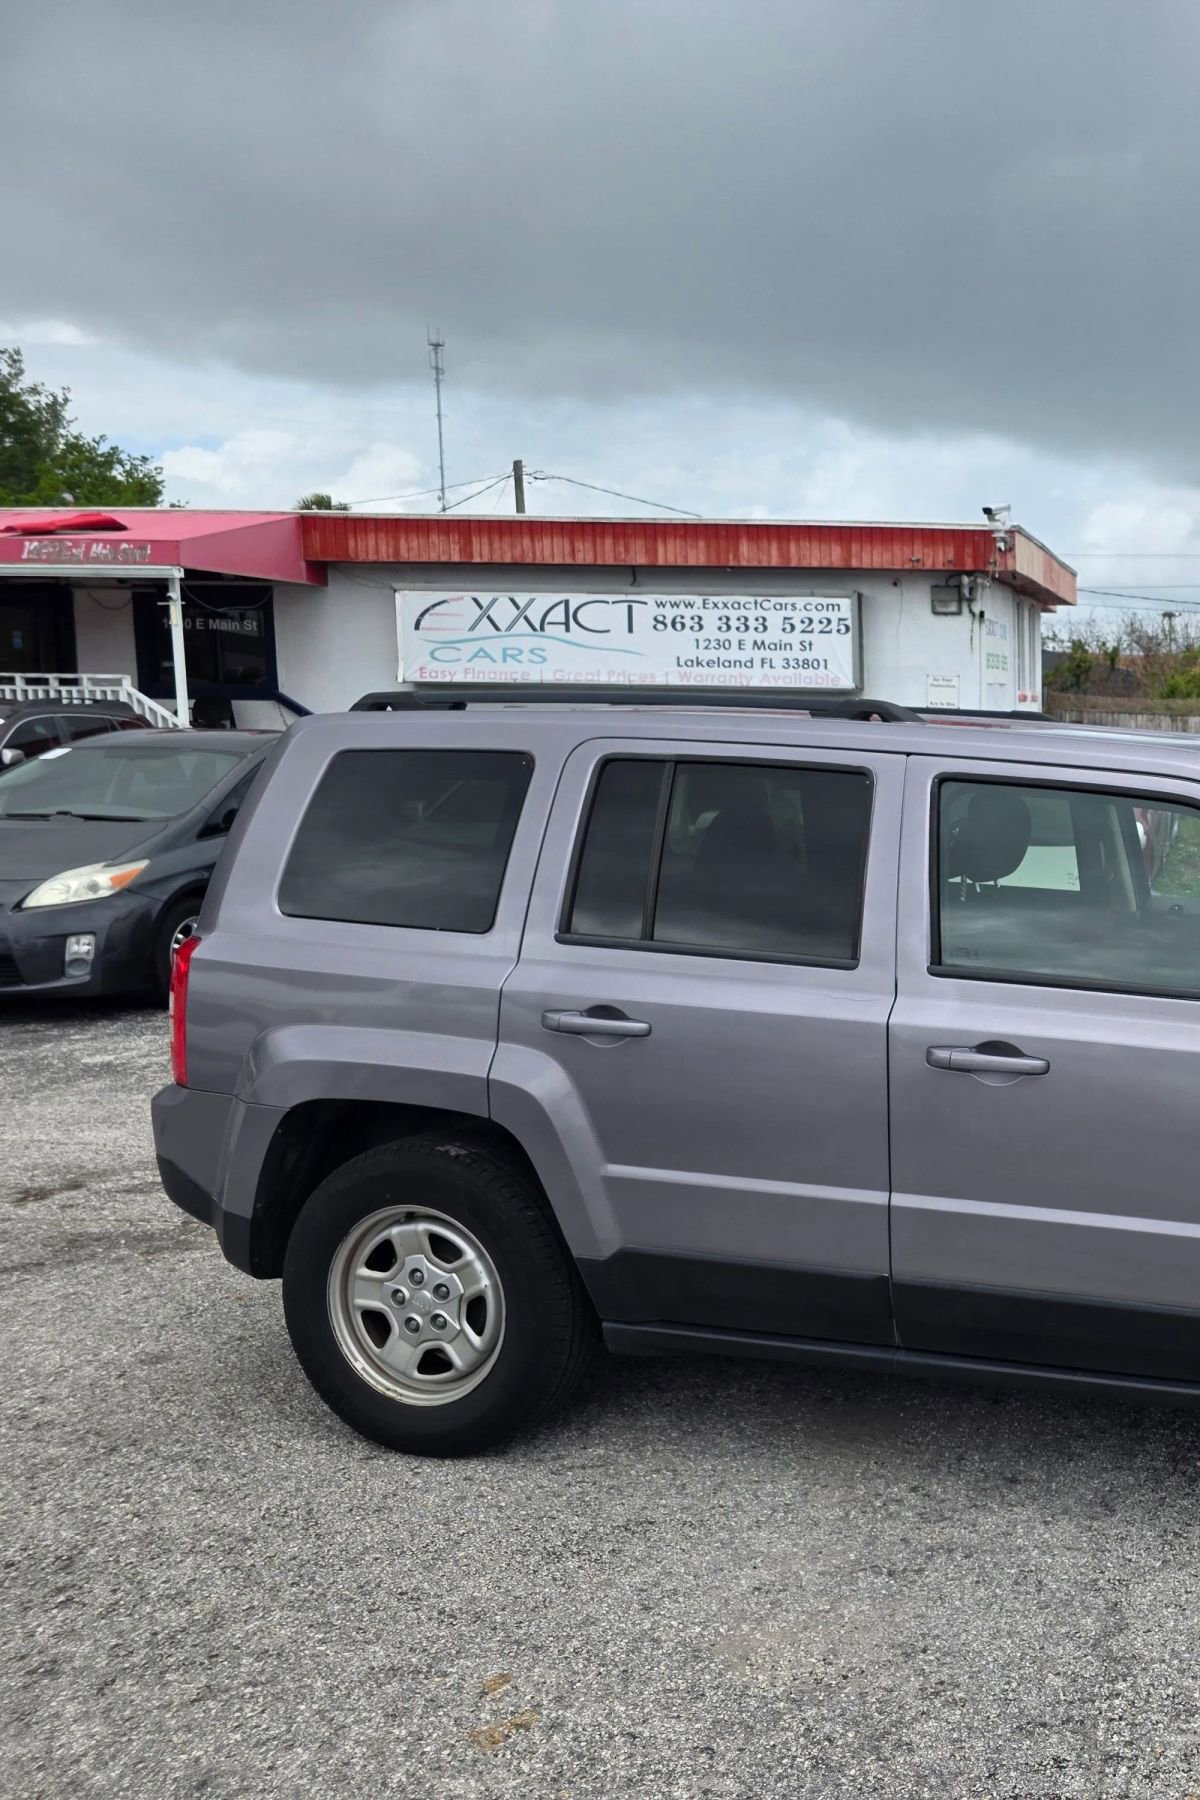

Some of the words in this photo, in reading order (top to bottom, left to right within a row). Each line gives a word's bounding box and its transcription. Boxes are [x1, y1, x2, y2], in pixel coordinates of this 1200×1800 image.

[654, 597, 842, 613] www.ExxactCars.com
[162, 617, 192, 630] 10
[195, 618, 206, 630] E
[208, 619, 241, 632] Main
[243, 619, 259, 632] St
[414, 597, 649, 634] EXXACT
[652, 613, 705, 633] 863
[716, 615, 770, 634] 333
[781, 616, 851, 635] 5225
[694, 638, 732, 651] 1230
[738, 639, 747, 651] E
[752, 639, 794, 652] Main
[799, 640, 814, 652] St
[429, 645, 549, 665] CARS
[676, 656, 755, 669] Lakeland
[760, 657, 777, 670] FL
[782, 657, 829, 671] 33801
[418, 666, 458, 682] Easy
[463, 667, 531, 681] Finance
[553, 668, 601, 682] Great
[607, 670, 657, 683] Prices
[677, 671, 753, 687] Warranty
[760, 671, 842, 687] Available
